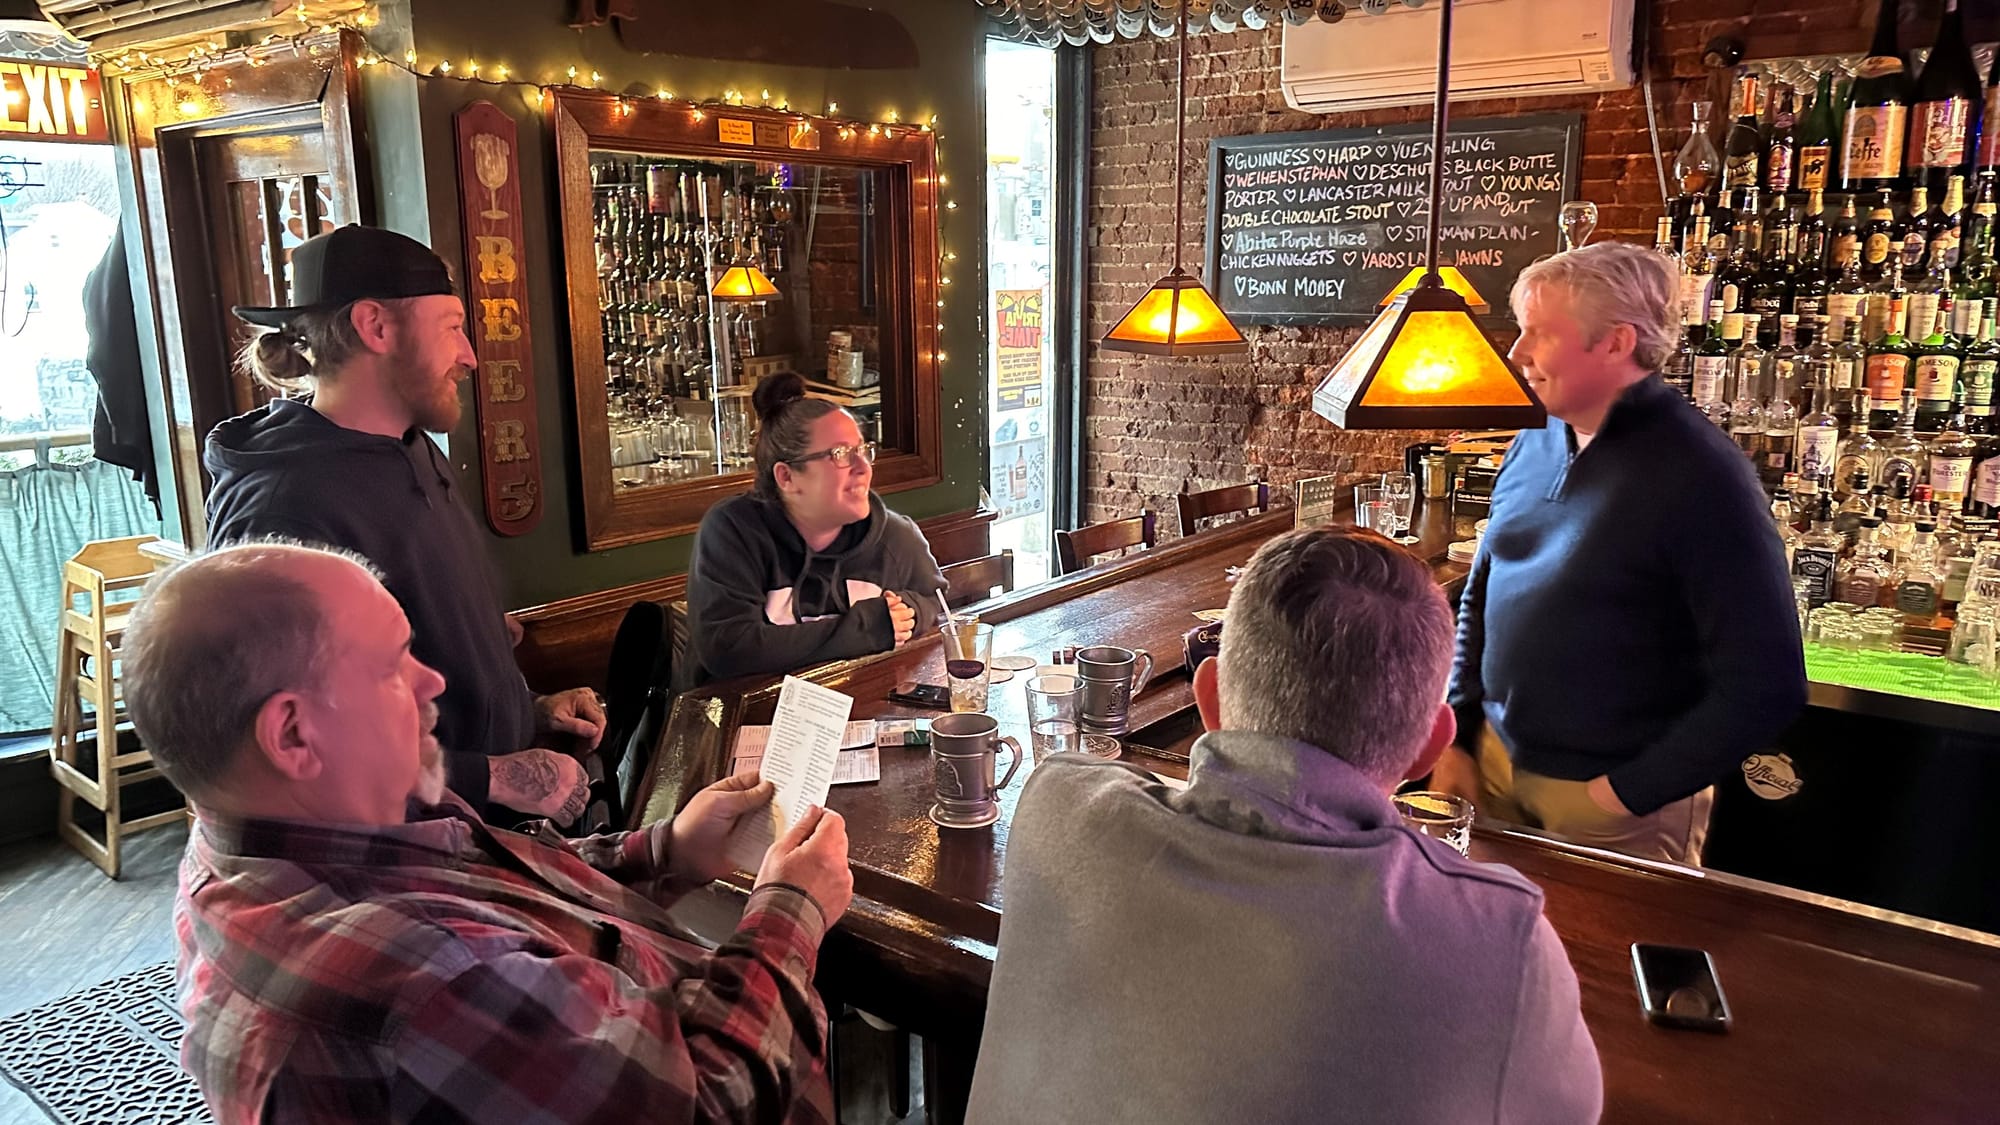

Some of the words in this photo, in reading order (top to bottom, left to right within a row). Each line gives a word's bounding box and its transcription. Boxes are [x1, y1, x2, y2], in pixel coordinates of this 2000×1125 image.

[0, 61, 88, 135] EXIT
[1235, 148, 1310, 170] GUINNESS
[1329, 145, 1372, 165] HARP
[1236, 165, 1349, 188] WEIHENSTEPHAN
[1369, 161, 1451, 181] DESCHUTS
[1455, 158, 1505, 174] BLACK
[1509, 153, 1557, 171] BUTTE
[1224, 190, 1280, 210] PORTER
[1300, 184, 1386, 204] LANCASTER
[1388, 181, 1427, 198] MILK
[1501, 171, 1561, 192] YOUNGS
[1221, 209, 1271, 231] DOUBLE
[1271, 205, 1342, 226] CHOCOLATE
[1345, 201, 1395, 220] STOUT
[1235, 231, 1278, 254] Abita
[1280, 229, 1325, 251] Purple
[1328, 229, 1368, 247] Haze
[1361, 249, 1406, 270] YARDS
[1455, 249, 1503, 267] JAWNS
[1248, 276, 1287, 298] BONN
[1294, 276, 1345, 300] MOOEY
